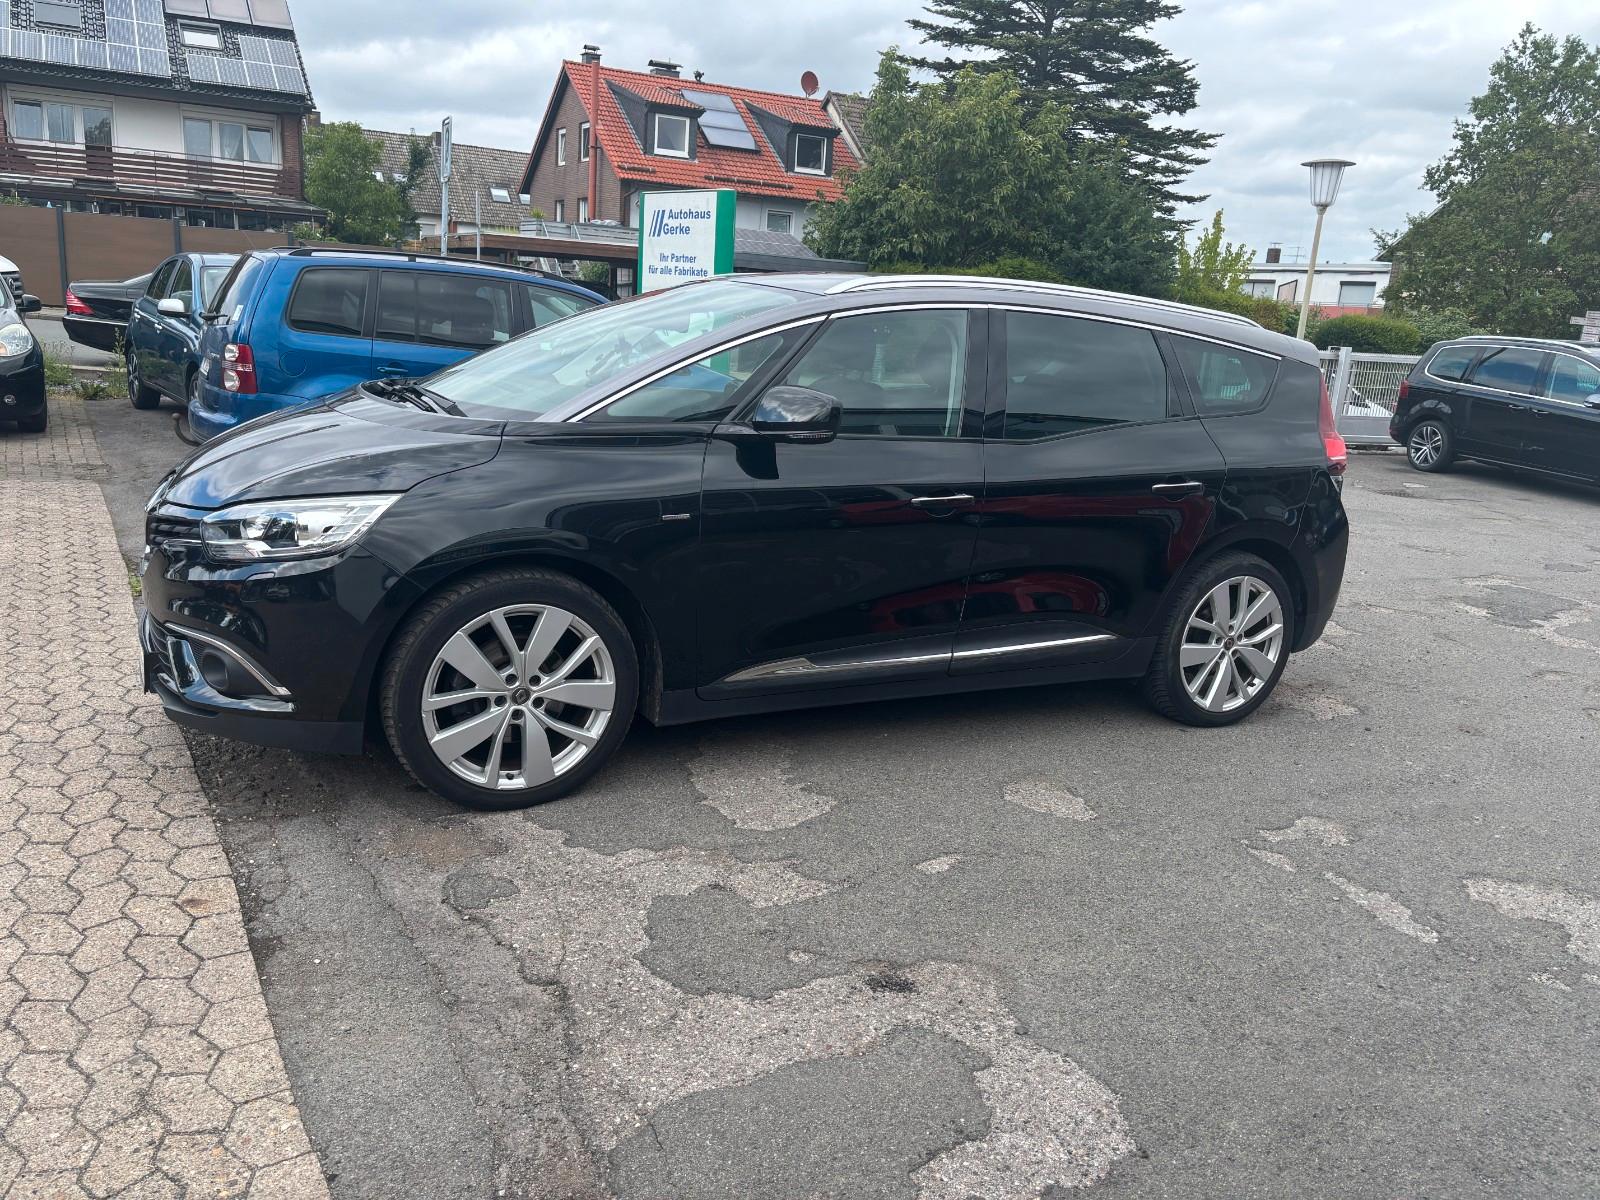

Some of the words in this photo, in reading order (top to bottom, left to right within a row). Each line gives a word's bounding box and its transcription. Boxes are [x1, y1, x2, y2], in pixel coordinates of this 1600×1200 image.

[668, 209, 711, 220] Autohaus
[663, 223, 690, 235] Gerke
[659, 252, 669, 262] Ihr
[670, 253, 697, 263] Partner
[648, 264, 658, 274] für
[659, 265, 672, 275] alle
[674, 266, 708, 277] Fabrikate
